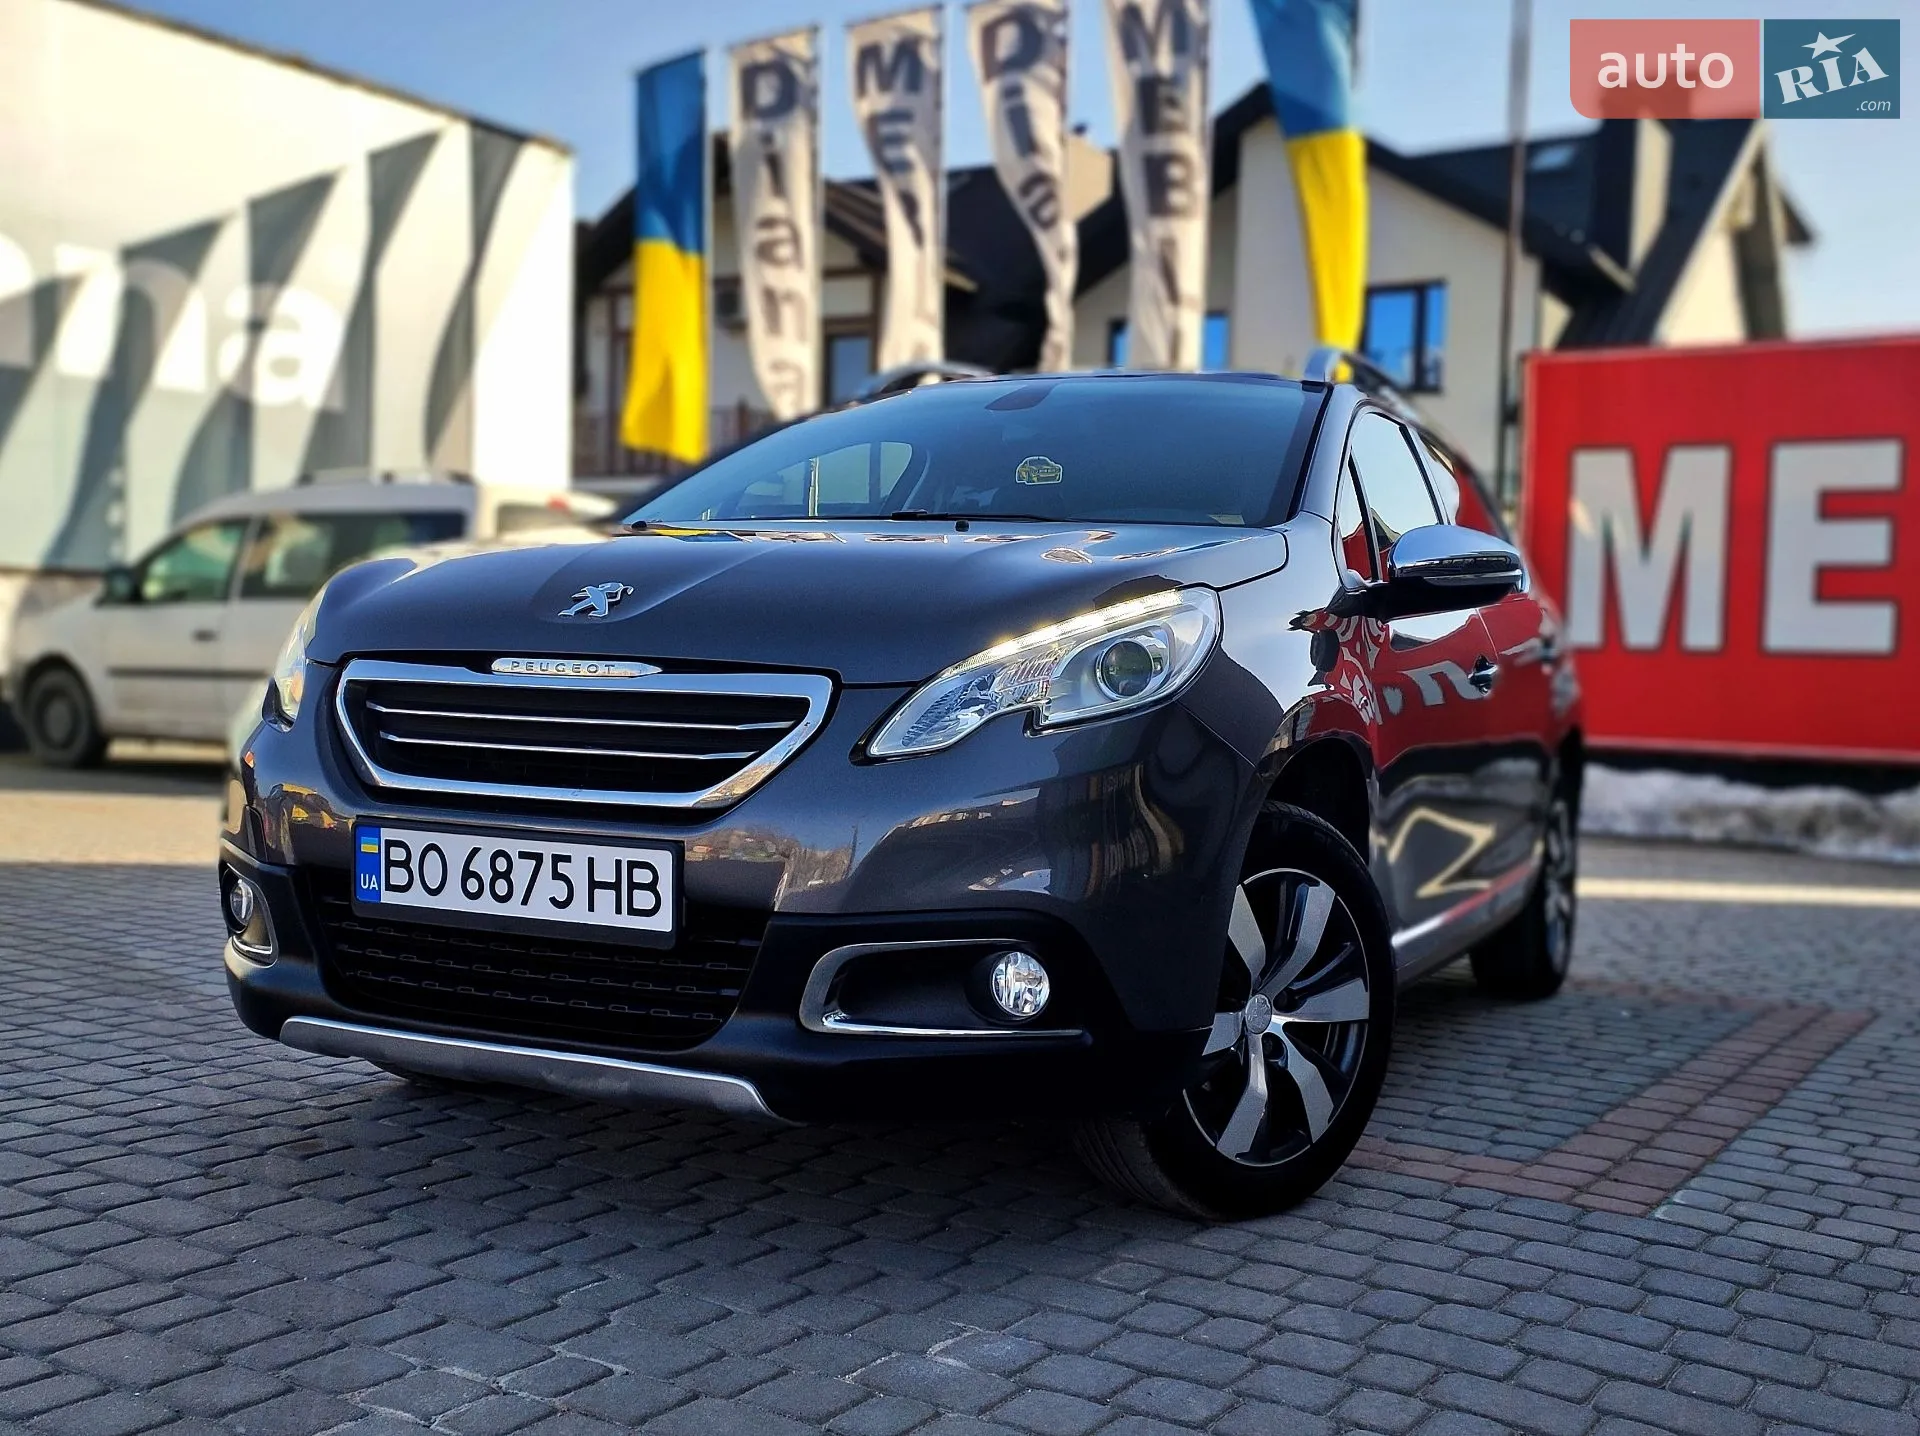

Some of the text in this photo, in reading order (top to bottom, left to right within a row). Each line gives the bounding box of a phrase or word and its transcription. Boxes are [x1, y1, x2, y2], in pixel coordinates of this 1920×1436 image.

[1568, 438, 1904, 655] ME
[511, 660, 615, 674] PEUGEOT
[360, 873, 379, 891] UA
[384, 838, 662, 918] BO 6875 HB
